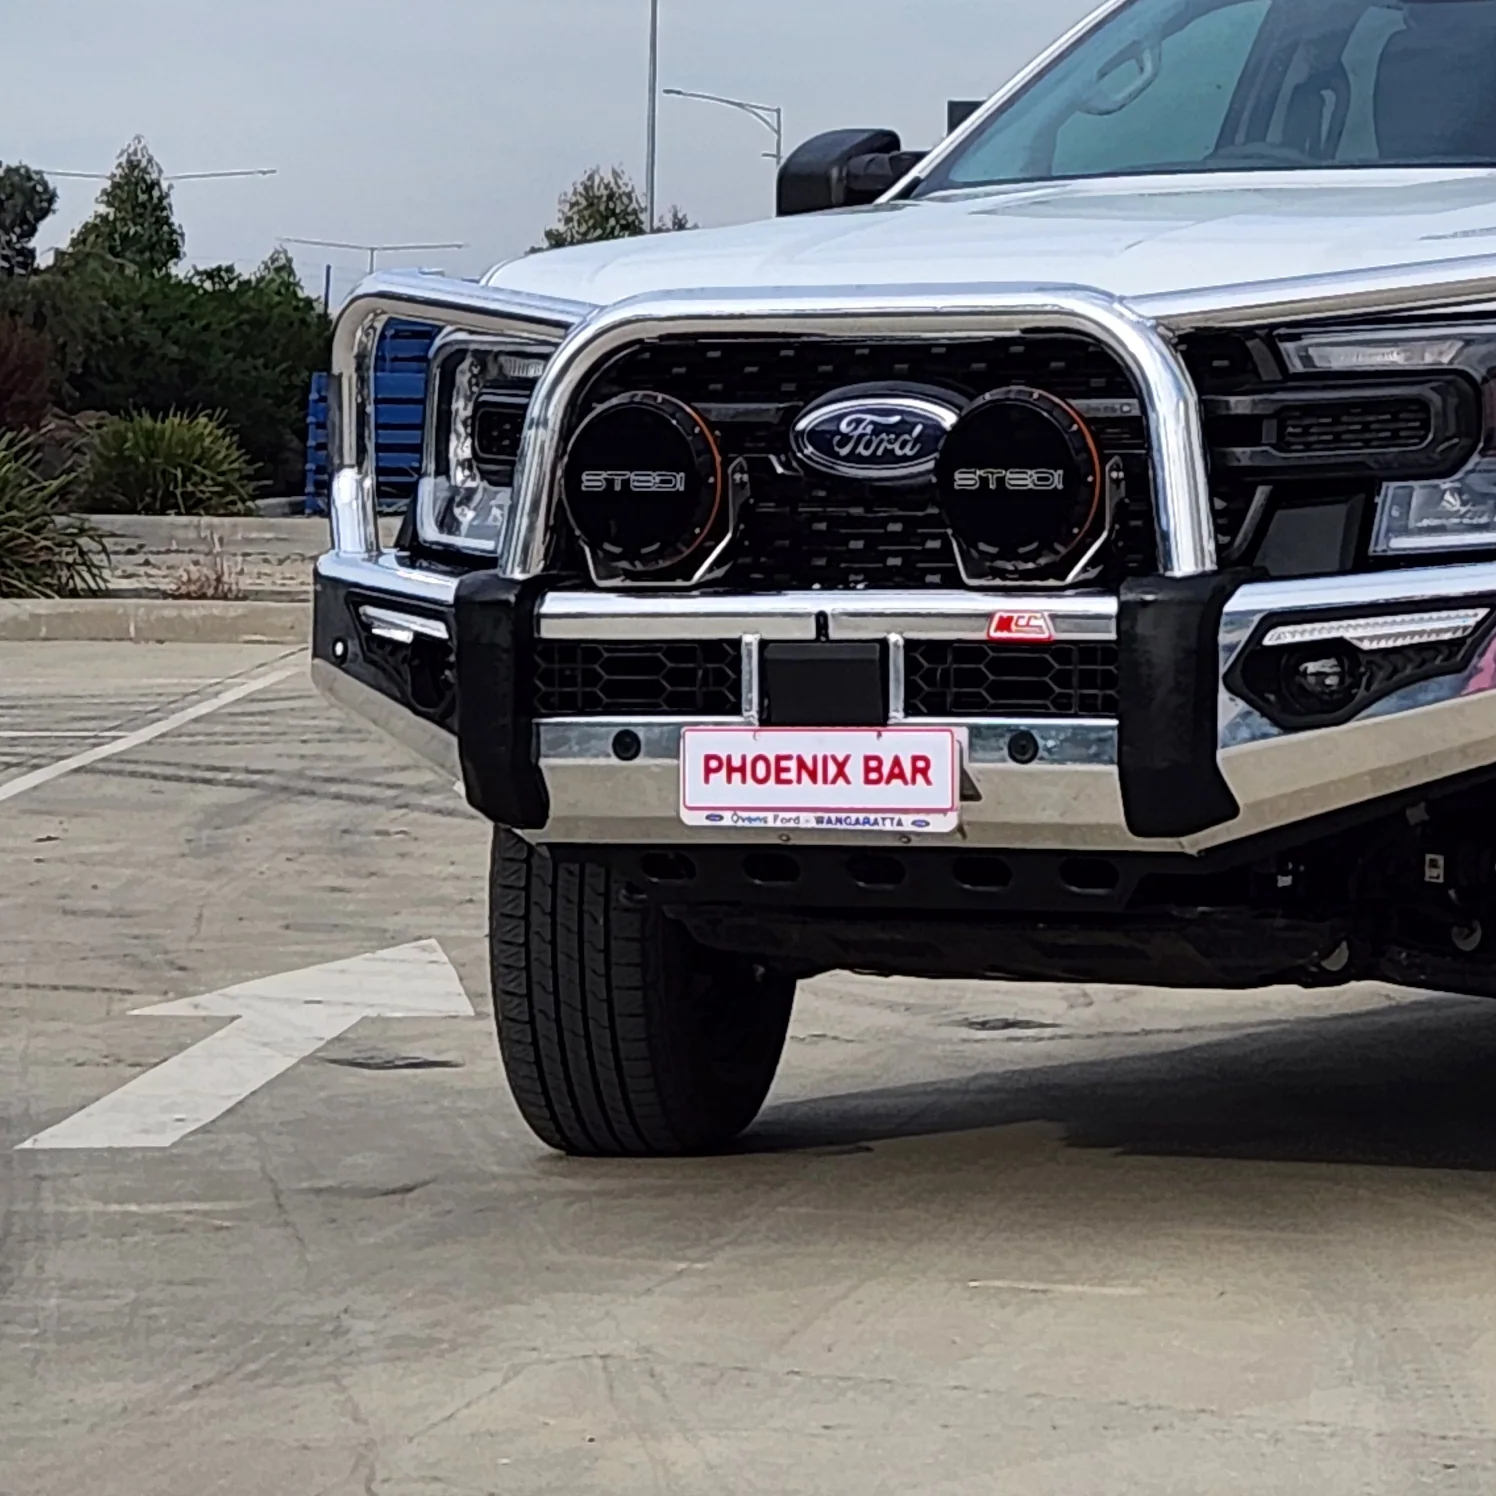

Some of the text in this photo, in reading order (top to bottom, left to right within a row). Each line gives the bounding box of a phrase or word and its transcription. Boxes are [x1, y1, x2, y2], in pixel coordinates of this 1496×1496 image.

[832, 413, 923, 457] Ford
[581, 471, 685, 491] STEDI
[954, 468, 1064, 490] STEDI
[703, 754, 933, 786] PHOENIX BAR
[772, 814, 800, 825] Ford
